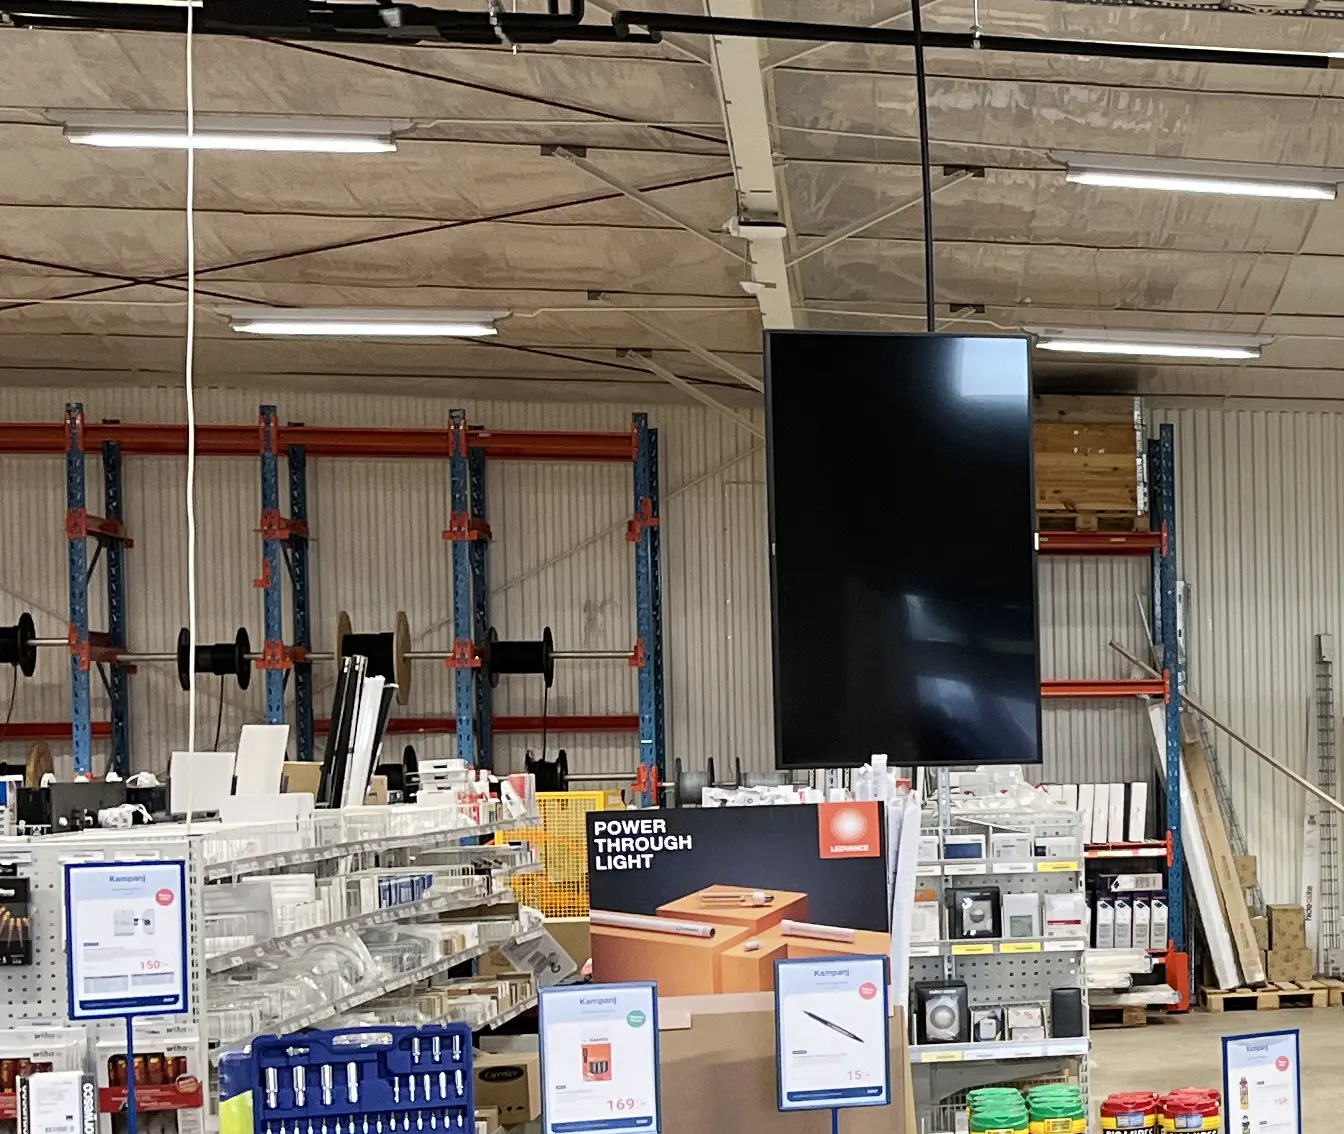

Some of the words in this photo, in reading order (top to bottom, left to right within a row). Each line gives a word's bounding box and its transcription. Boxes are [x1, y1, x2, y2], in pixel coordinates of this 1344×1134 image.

[594, 819, 667, 836] POWER
[594, 835, 693, 854] THROUGH
[595, 853, 654, 871] LIGHT
